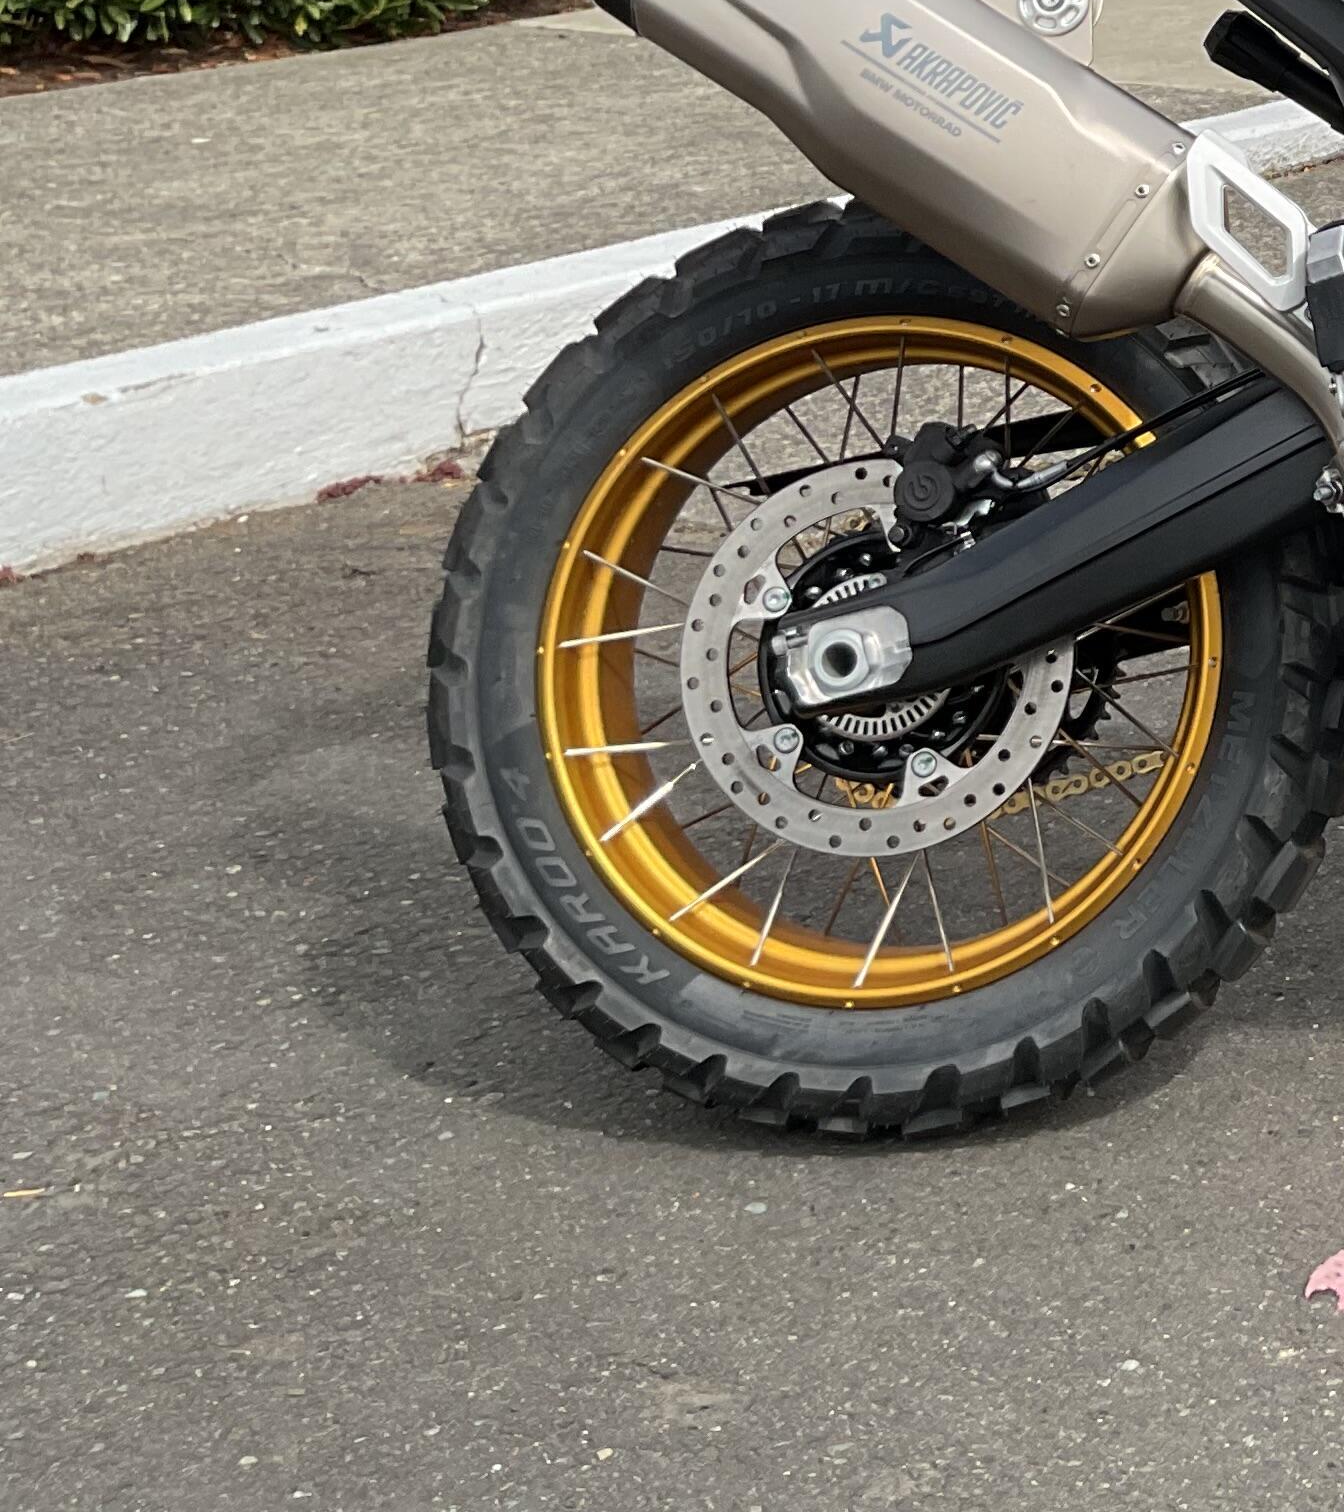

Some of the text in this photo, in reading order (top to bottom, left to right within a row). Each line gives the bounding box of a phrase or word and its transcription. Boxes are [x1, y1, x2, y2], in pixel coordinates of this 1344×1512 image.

[859, 68, 963, 138] BMW MOTORRAD
[499, 766, 671, 986] KAROO 4
